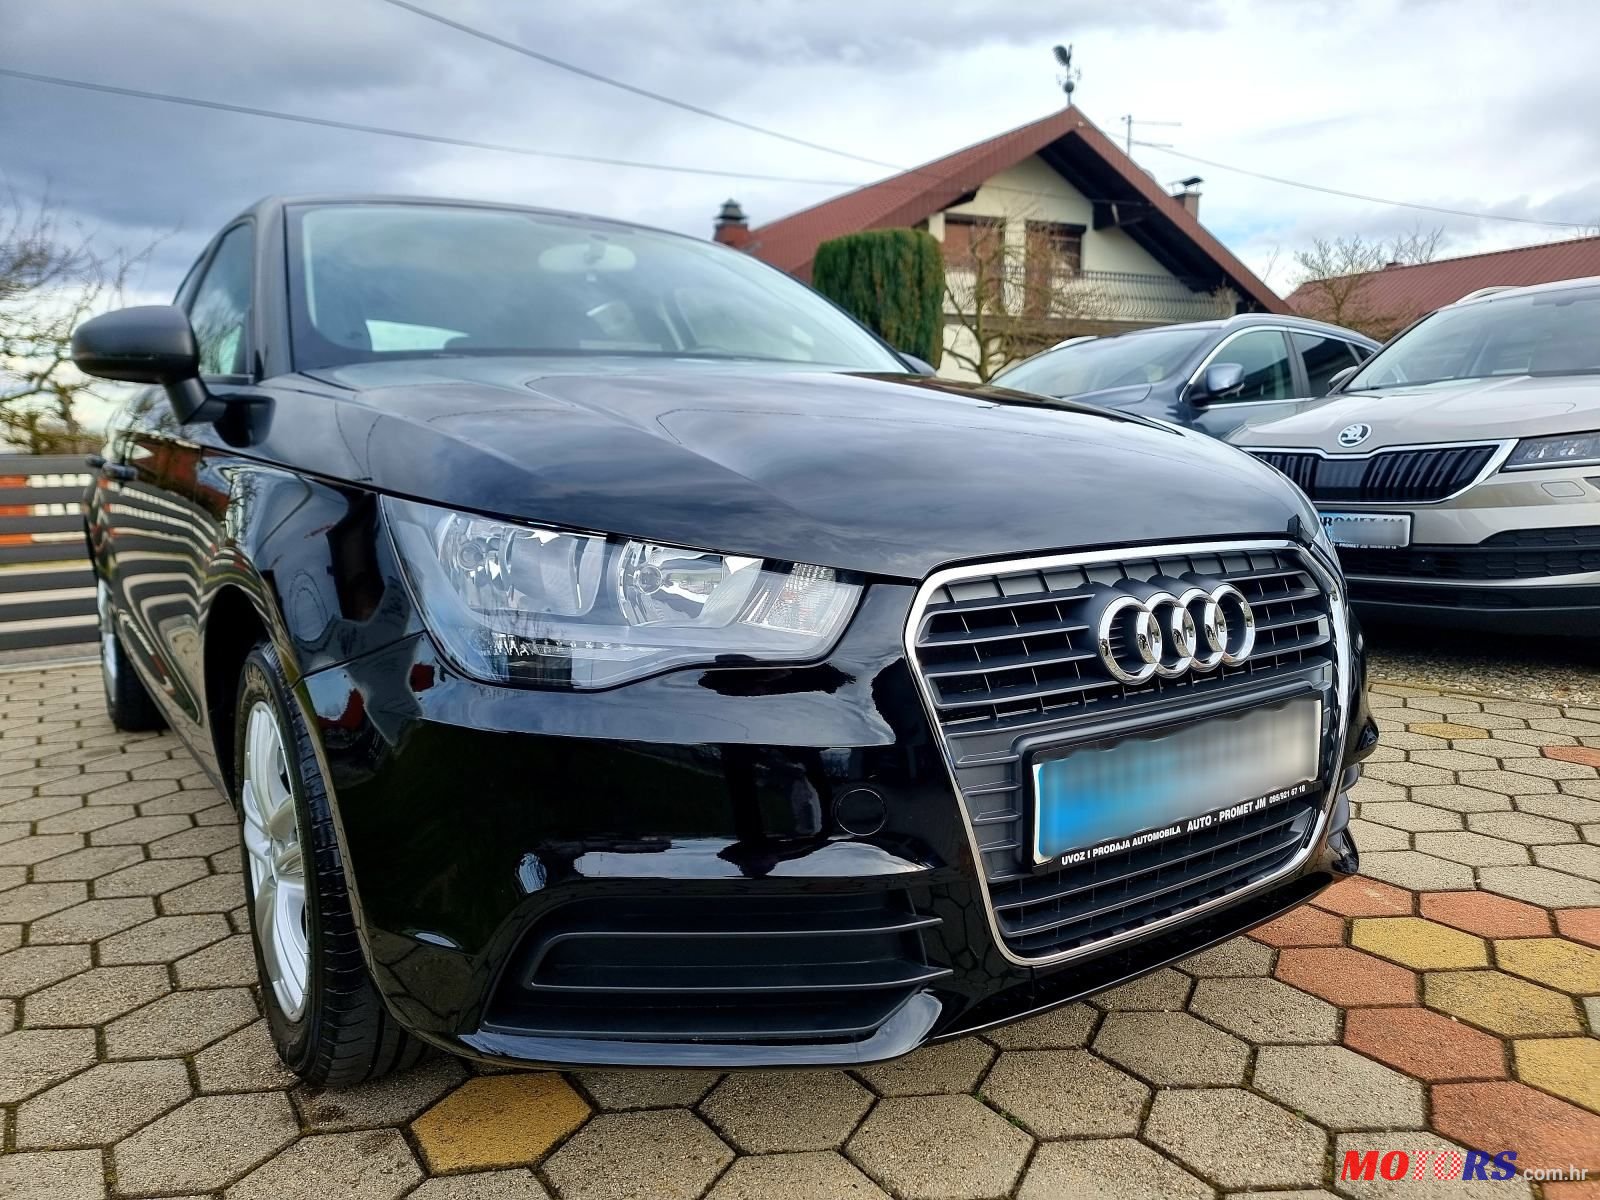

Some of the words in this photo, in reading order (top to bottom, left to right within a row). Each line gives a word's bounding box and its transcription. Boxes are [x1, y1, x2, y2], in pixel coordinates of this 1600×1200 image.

[1061, 852, 1086, 866] UVOZ
[1092, 840, 1131, 858] PRODAJA
[1132, 825, 1181, 847] AUTOMOBILA
[1186, 815, 1212, 833] AUTO
[1219, 801, 1254, 822] PROMET
[1254, 797, 1267, 810] JM
